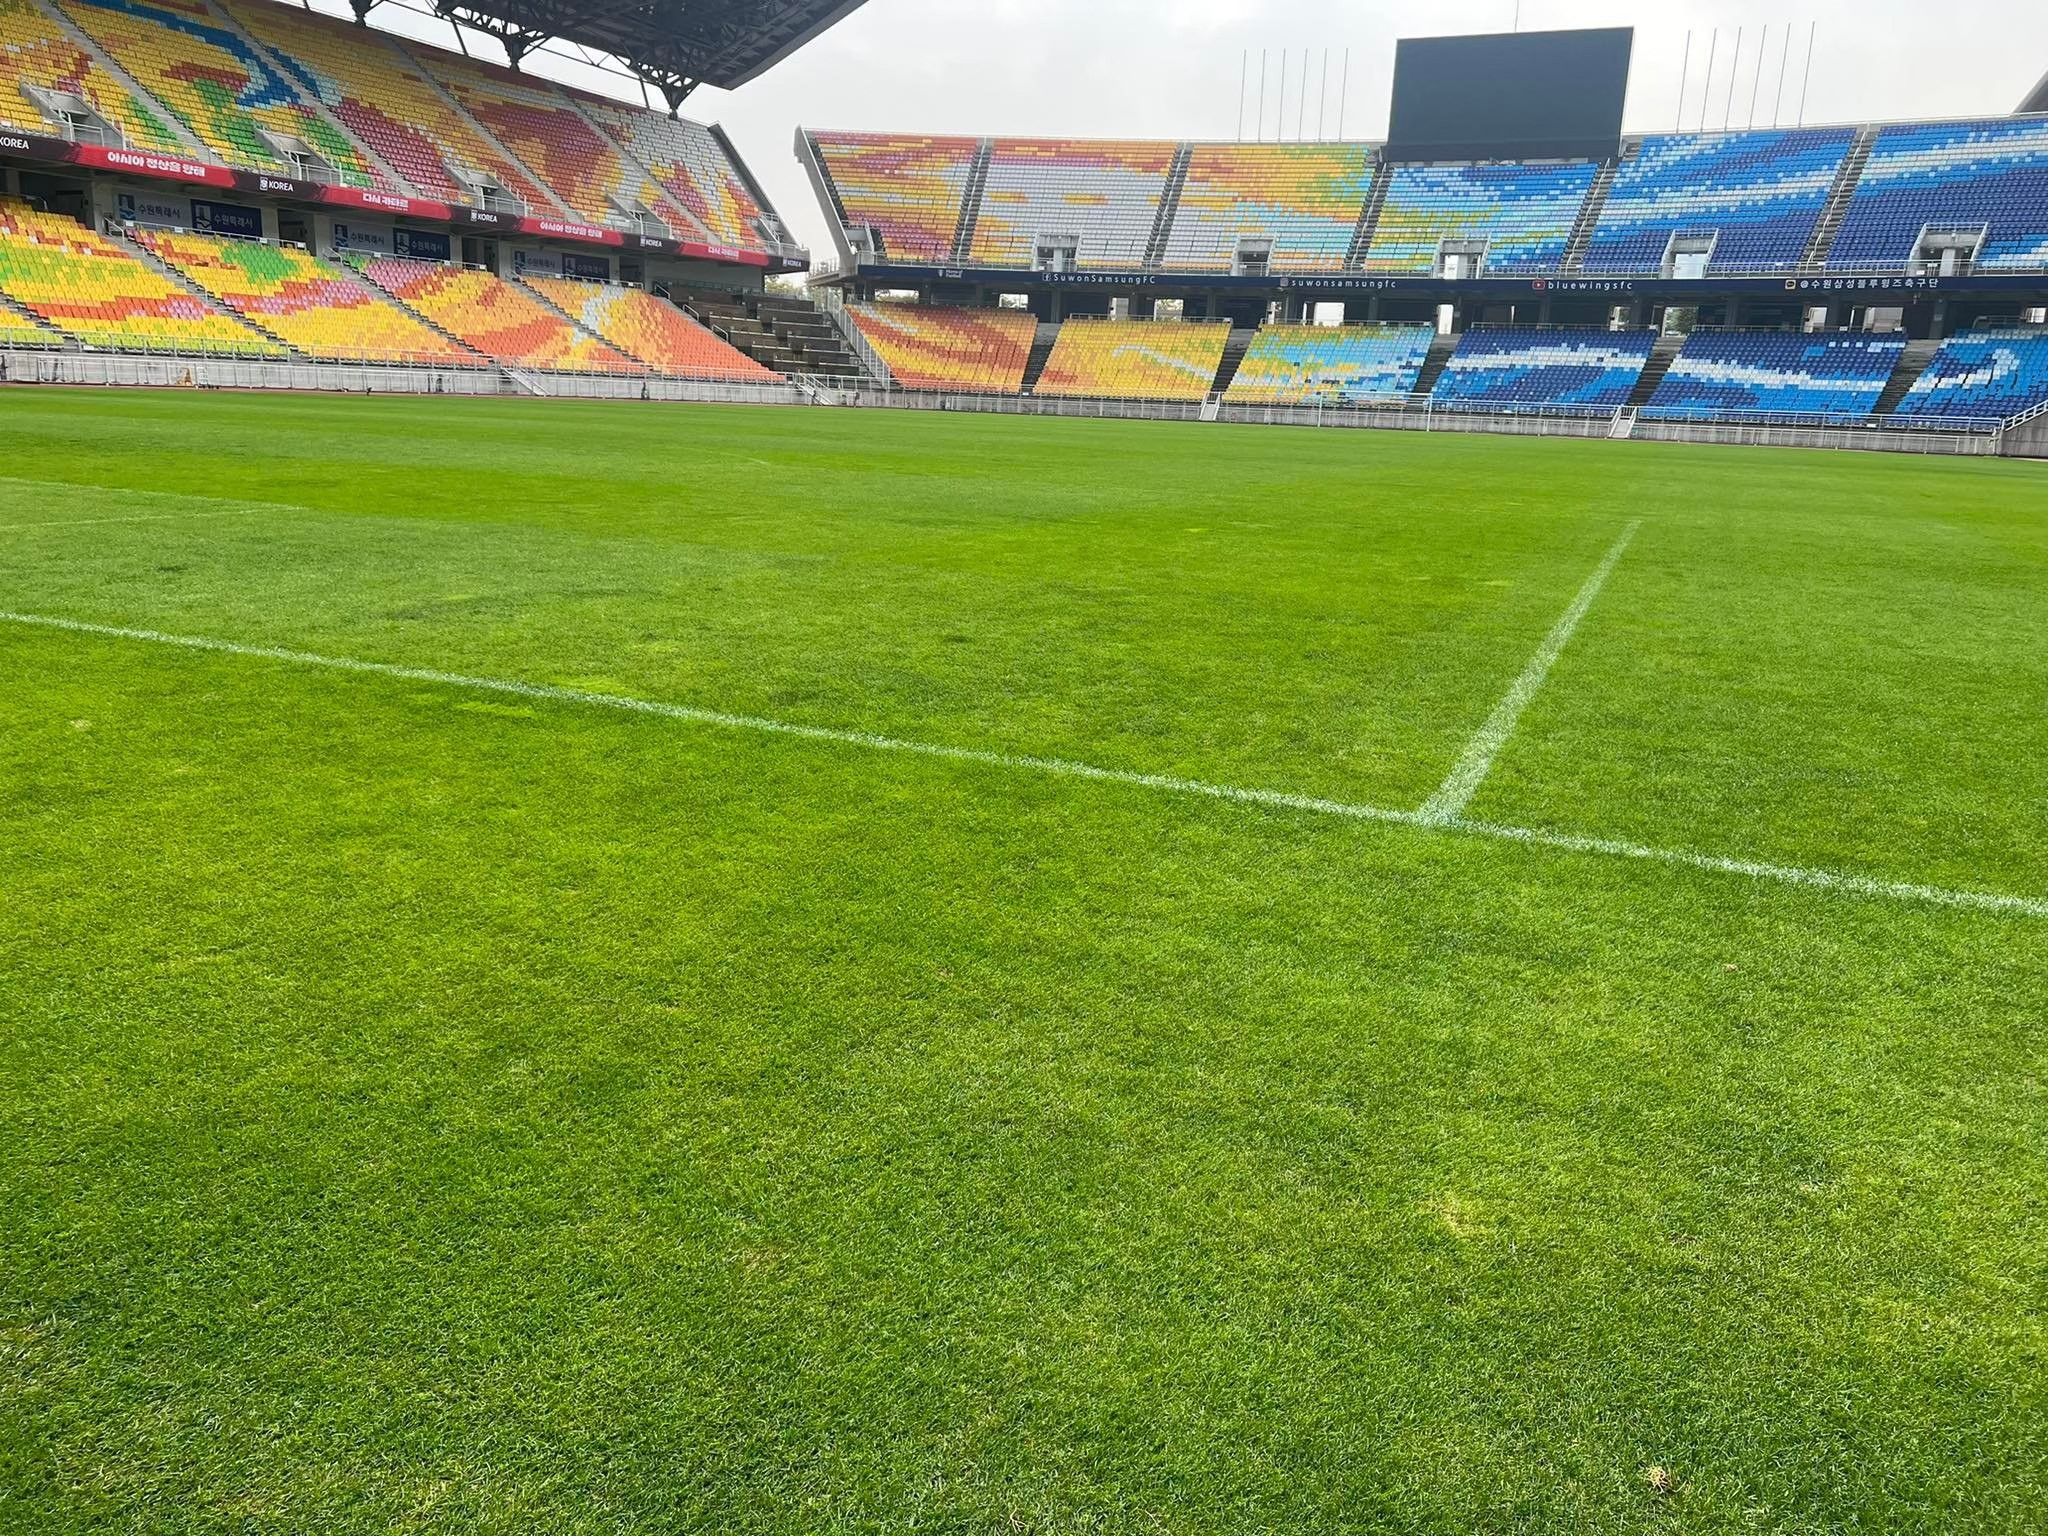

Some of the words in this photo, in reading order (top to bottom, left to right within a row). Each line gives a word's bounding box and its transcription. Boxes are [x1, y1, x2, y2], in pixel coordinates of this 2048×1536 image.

[107, 152, 144, 167] 아시아
[268, 180, 294, 192] KOREA
[363, 193, 380, 204] 다시
[140, 204, 180, 218] 수원특례시
[214, 214, 253, 227] 수원특례시
[478, 213, 497, 223] KOREA
[645, 239, 663, 248] KOREA
[1054, 274, 1155, 284] SuwonSamsungFC
[1291, 280, 1395, 288] suwonsamsungfc
[1800, 279, 1938, 288] @수원삼성블루윙즈축구단
[1548, 281, 1632, 290] bluewingsfc
